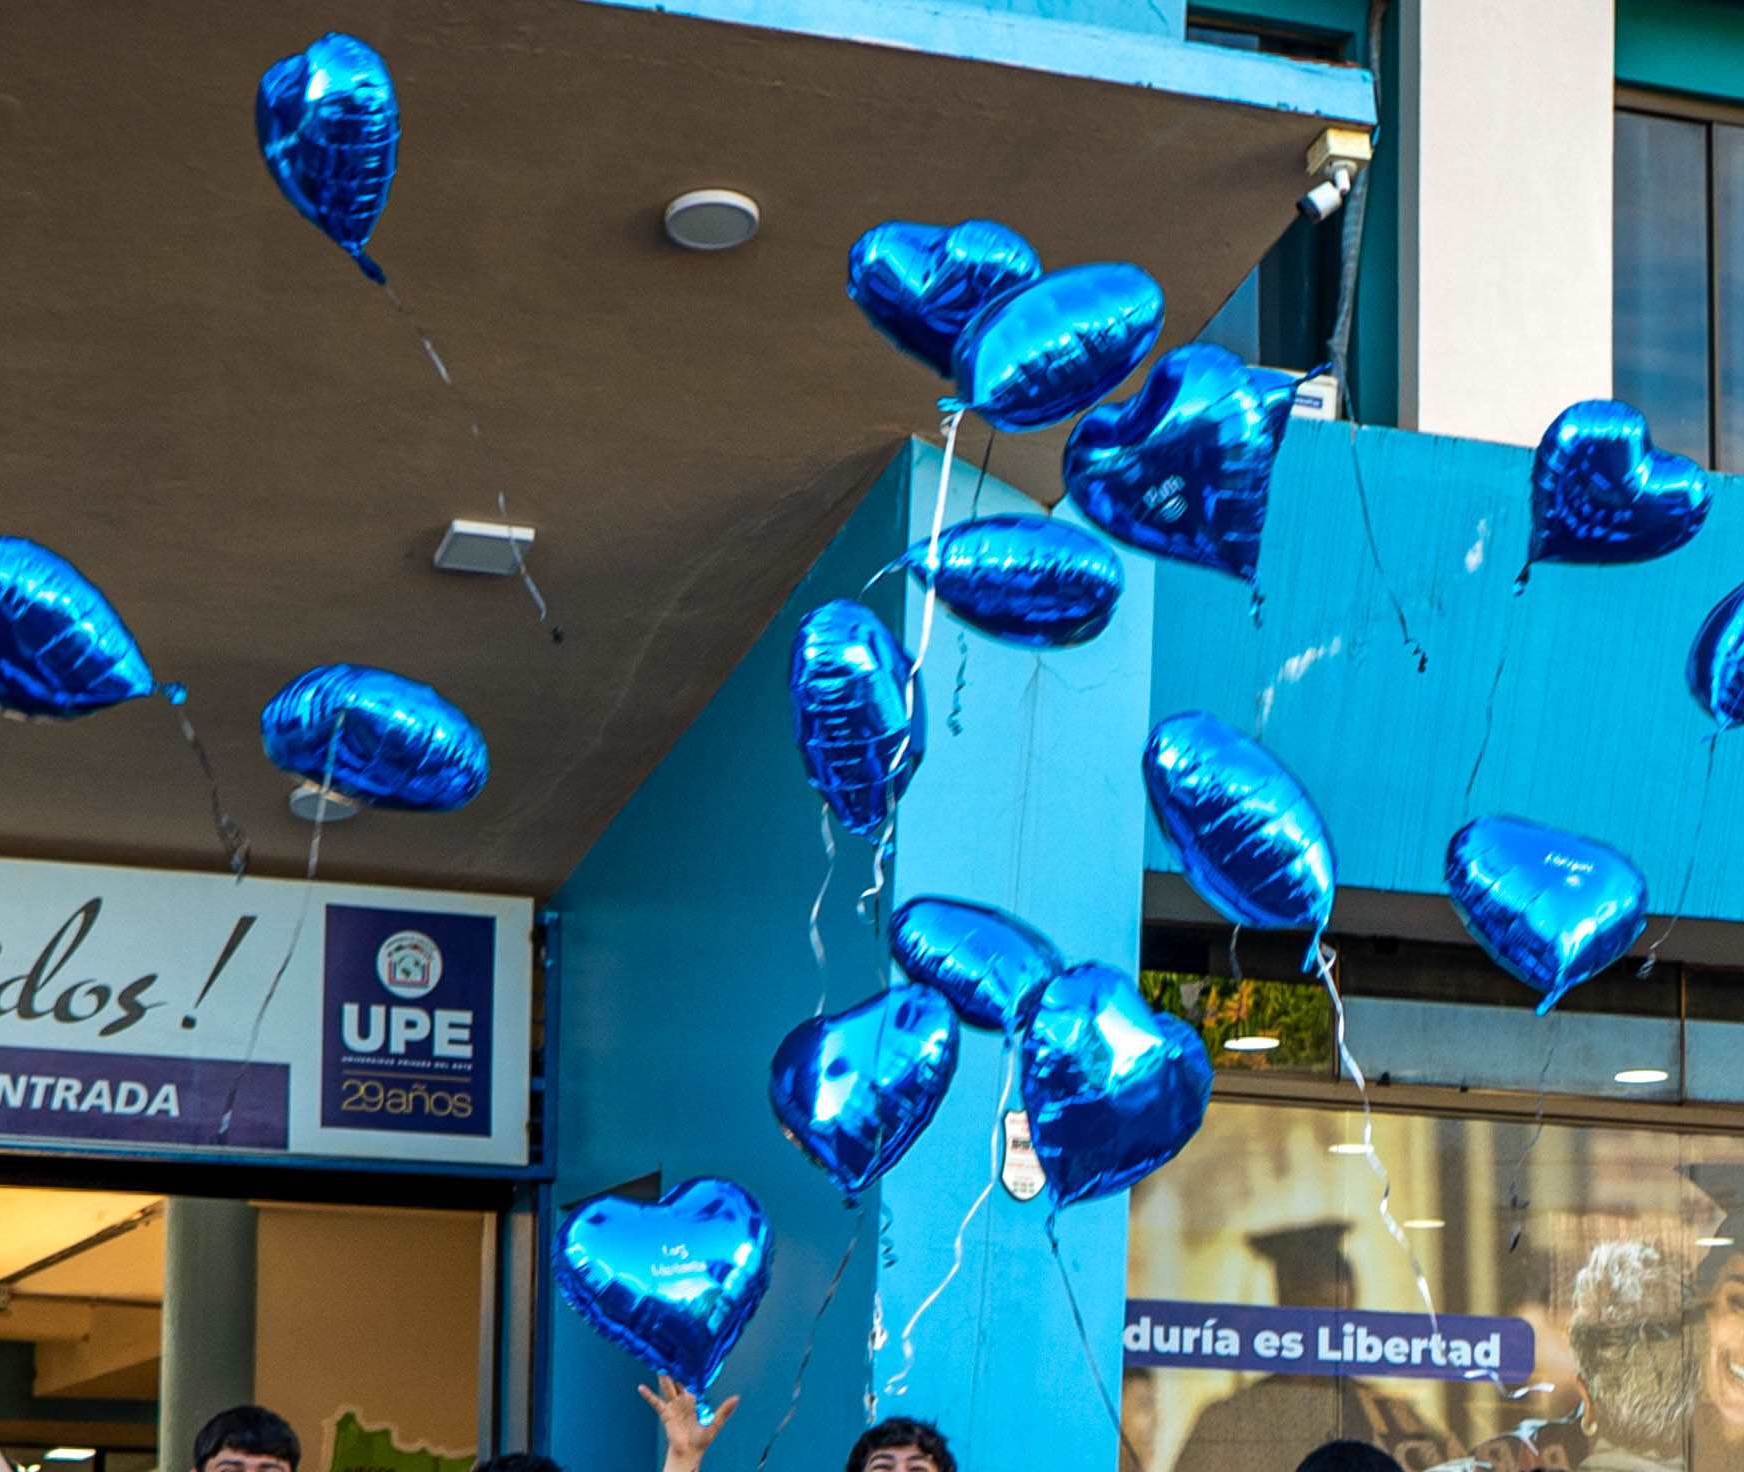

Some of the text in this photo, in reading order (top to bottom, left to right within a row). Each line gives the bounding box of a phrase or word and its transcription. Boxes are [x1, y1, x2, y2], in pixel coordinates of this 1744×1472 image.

[342, 1003, 473, 1059] UPE
[1255, 1329, 1304, 1360] es
[1317, 1324, 1501, 1369] Libertad
